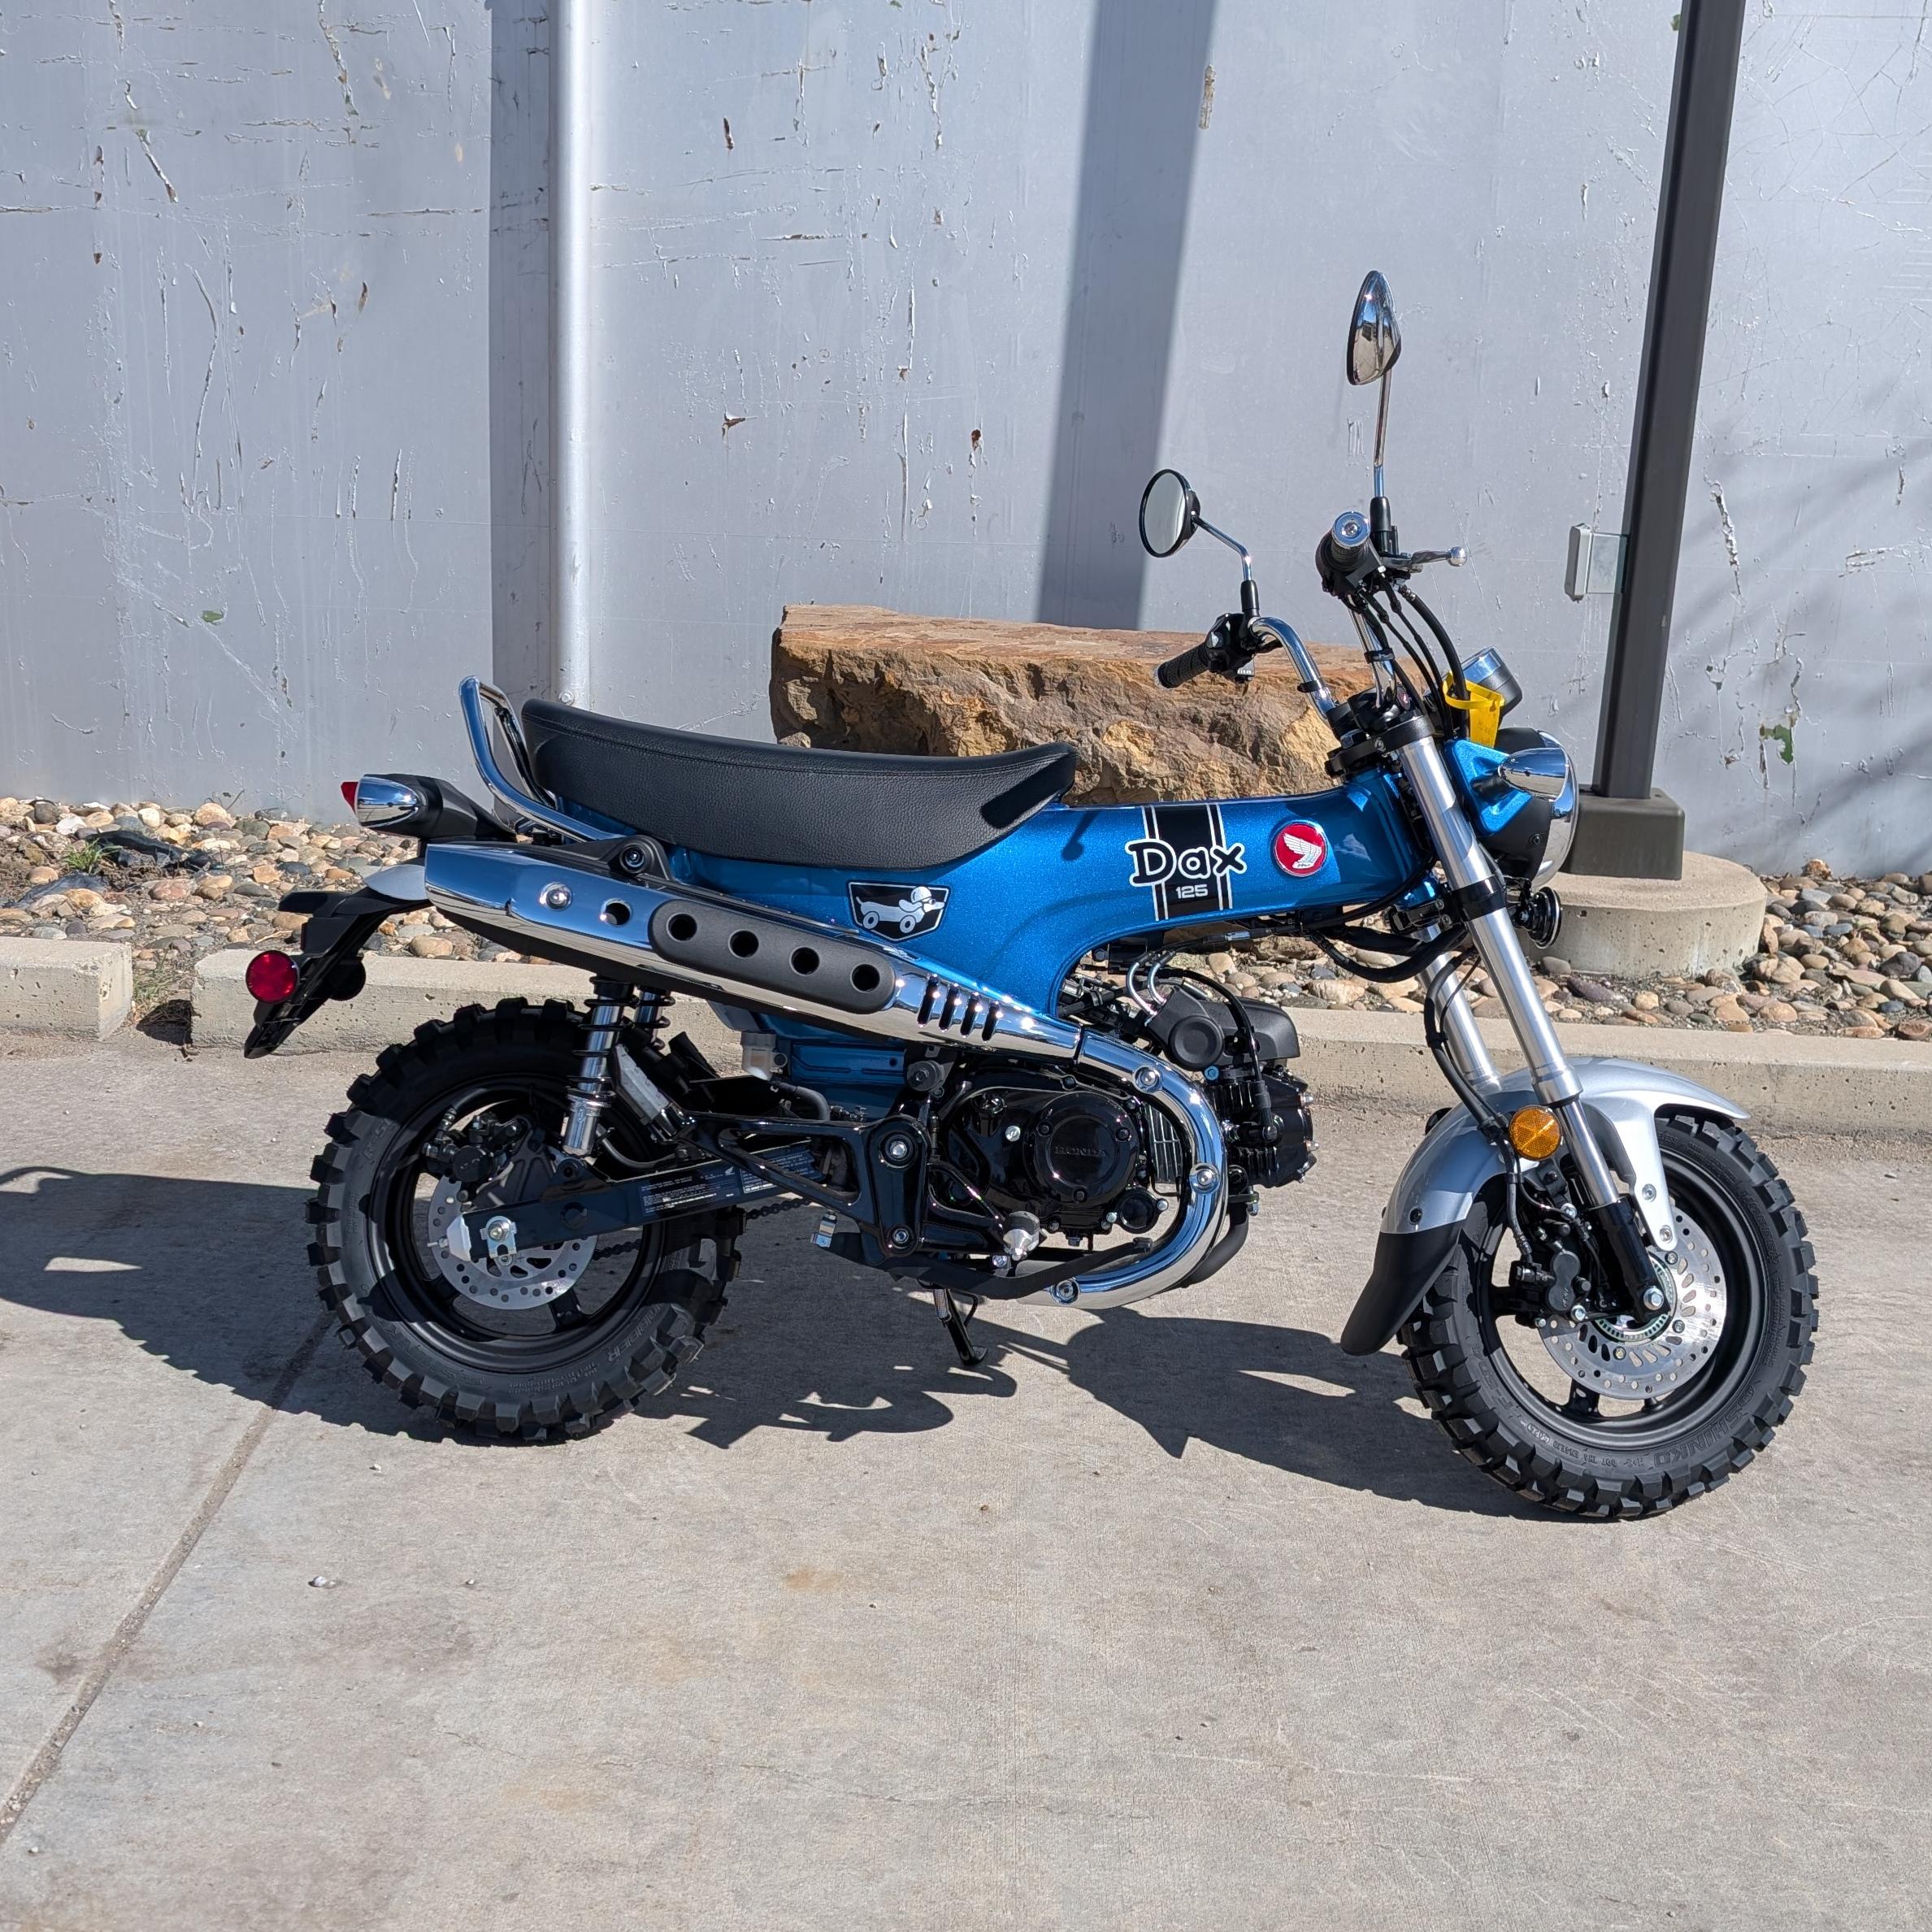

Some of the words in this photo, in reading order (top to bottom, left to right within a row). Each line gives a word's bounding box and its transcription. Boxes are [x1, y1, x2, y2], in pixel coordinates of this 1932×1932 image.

[1125, 838, 1247, 887] Dax
[1175, 884, 1209, 899] 125
[1653, 1406, 1747, 1466] SHINKO
